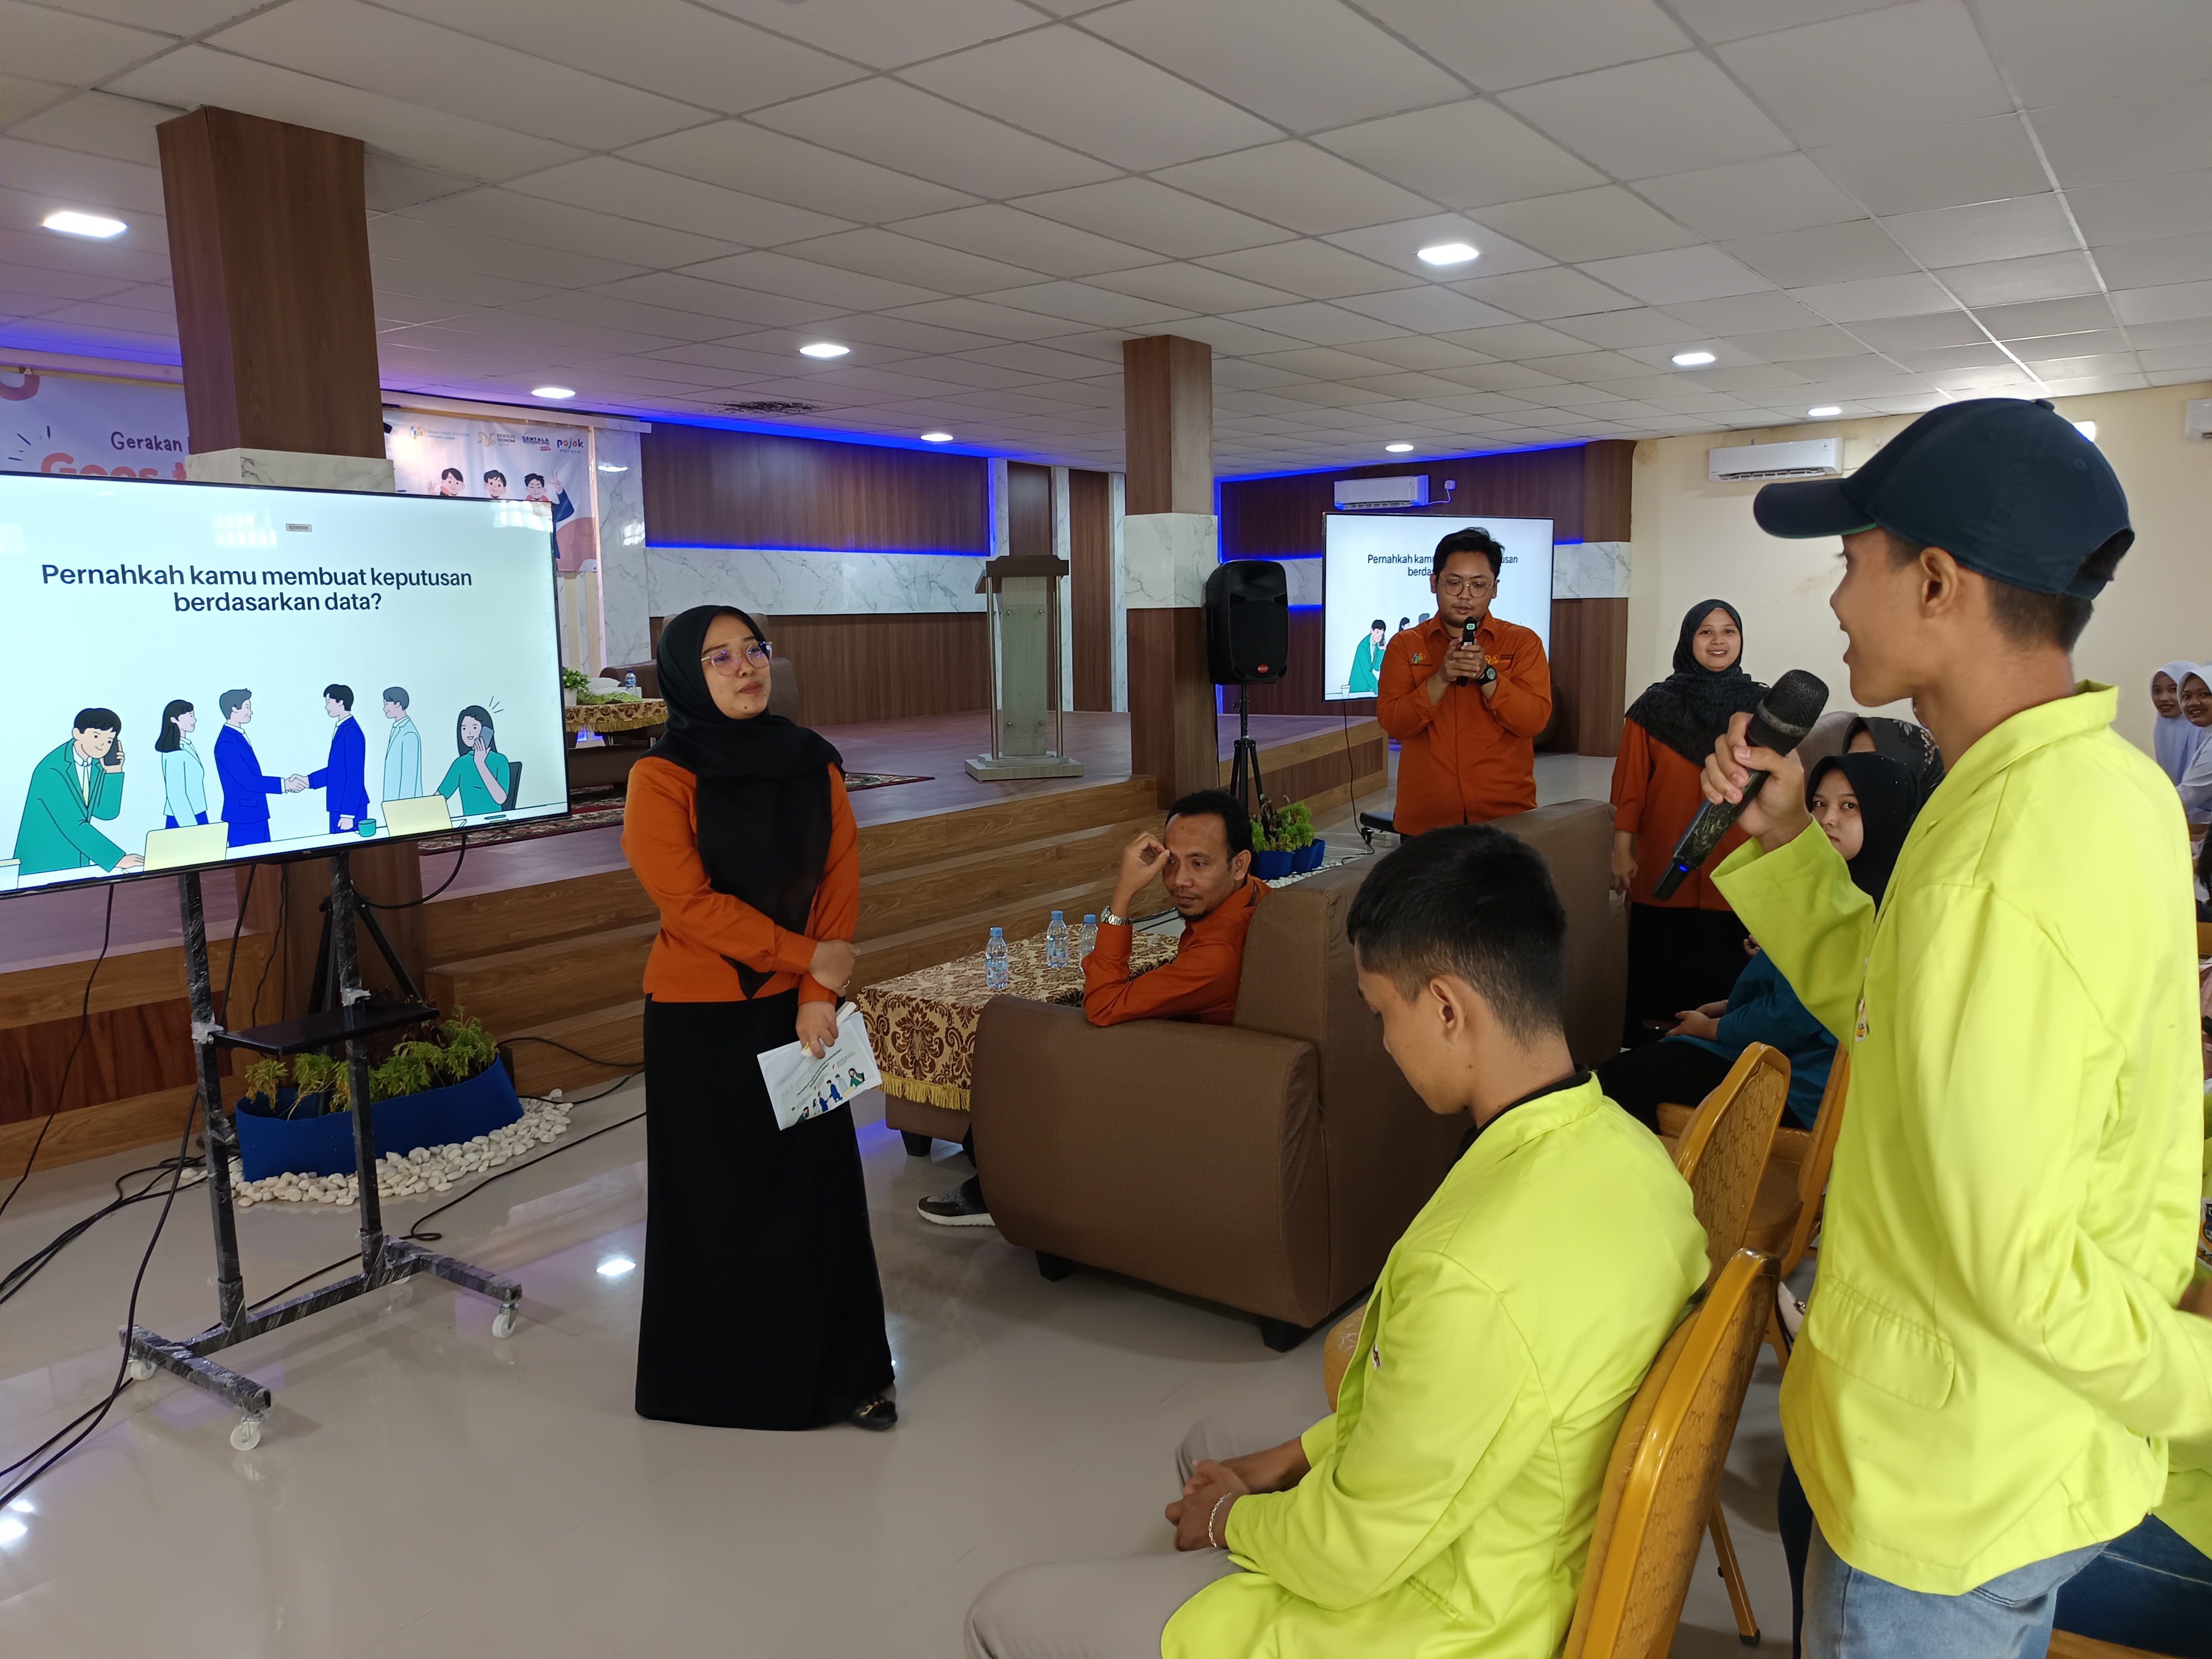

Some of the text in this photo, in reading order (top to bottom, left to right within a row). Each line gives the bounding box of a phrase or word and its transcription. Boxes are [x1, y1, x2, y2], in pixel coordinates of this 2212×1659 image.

[111, 431, 182, 452] Gerakan
[1368, 554, 1413, 564] Pernahkah
[41, 564, 472, 590] Pernahkah kamu membuat keputusan
[174, 592, 382, 612] berdasarkan data?
